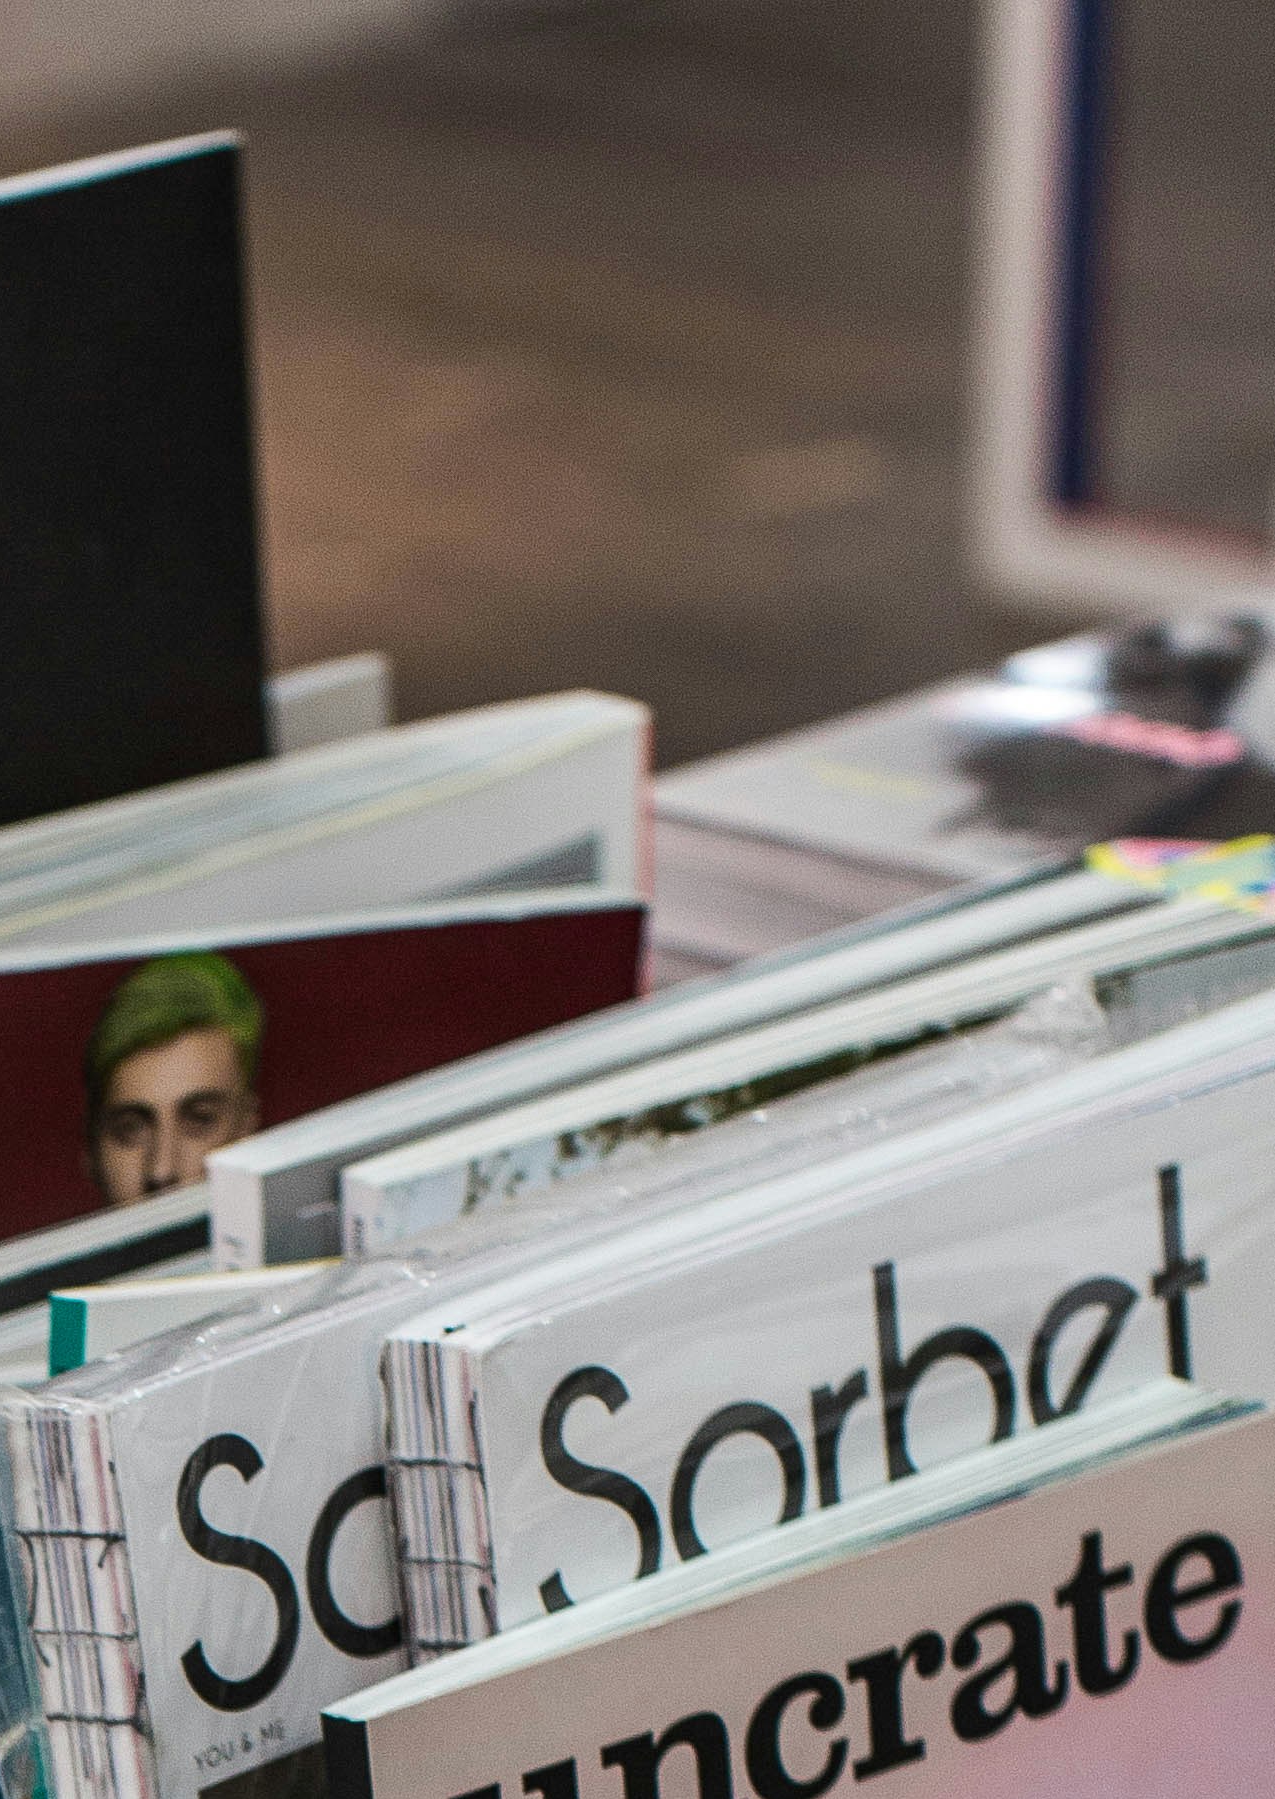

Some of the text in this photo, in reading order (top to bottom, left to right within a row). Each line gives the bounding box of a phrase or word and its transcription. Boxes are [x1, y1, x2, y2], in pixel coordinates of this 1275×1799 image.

[193, 1720, 286, 1770] YOU & ME
